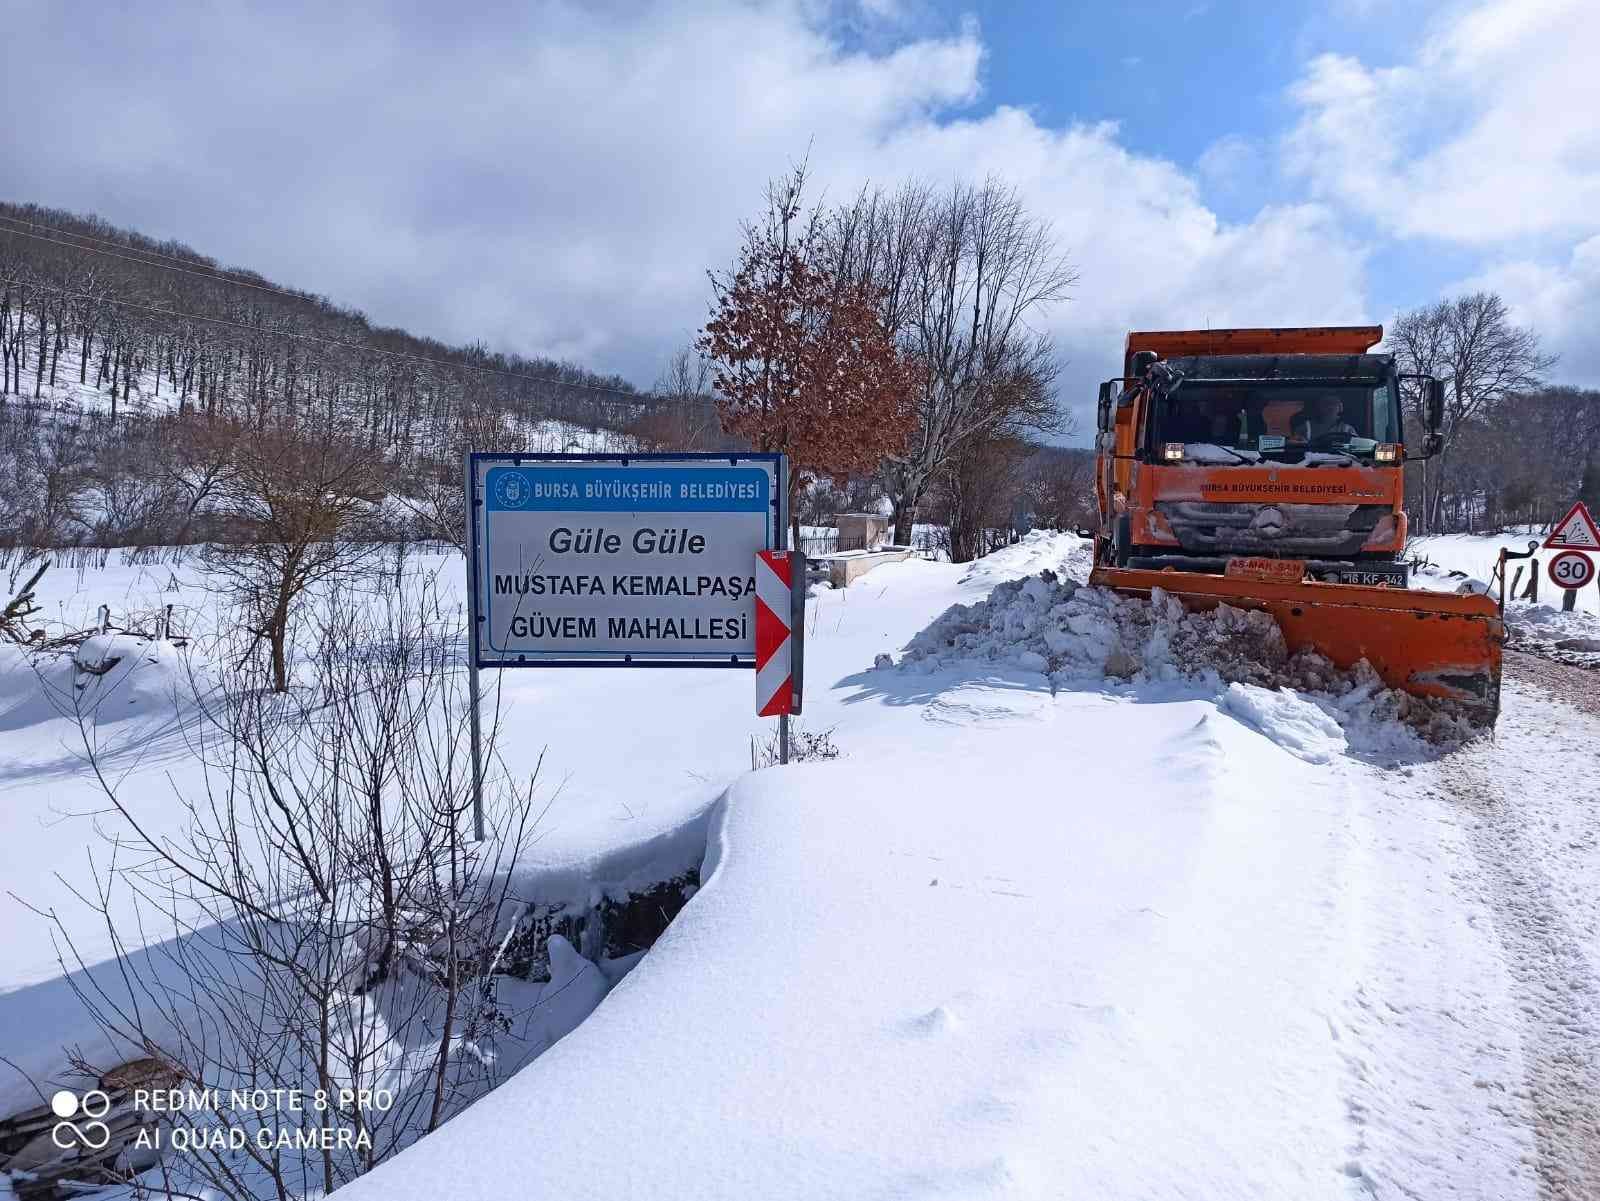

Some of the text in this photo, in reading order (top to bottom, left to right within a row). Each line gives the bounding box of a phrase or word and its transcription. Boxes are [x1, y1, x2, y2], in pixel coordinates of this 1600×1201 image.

[534, 479, 760, 501] BURSA BÜYÜKŞEHİR BELEDİYESİ
[549, 527, 706, 554] Güle Güle
[1557, 561, 1586, 579] 30
[495, 575, 756, 601] MUSTAFA KEMALPAŞA
[512, 612, 747, 640] GÜVEM MAHALLESİ
